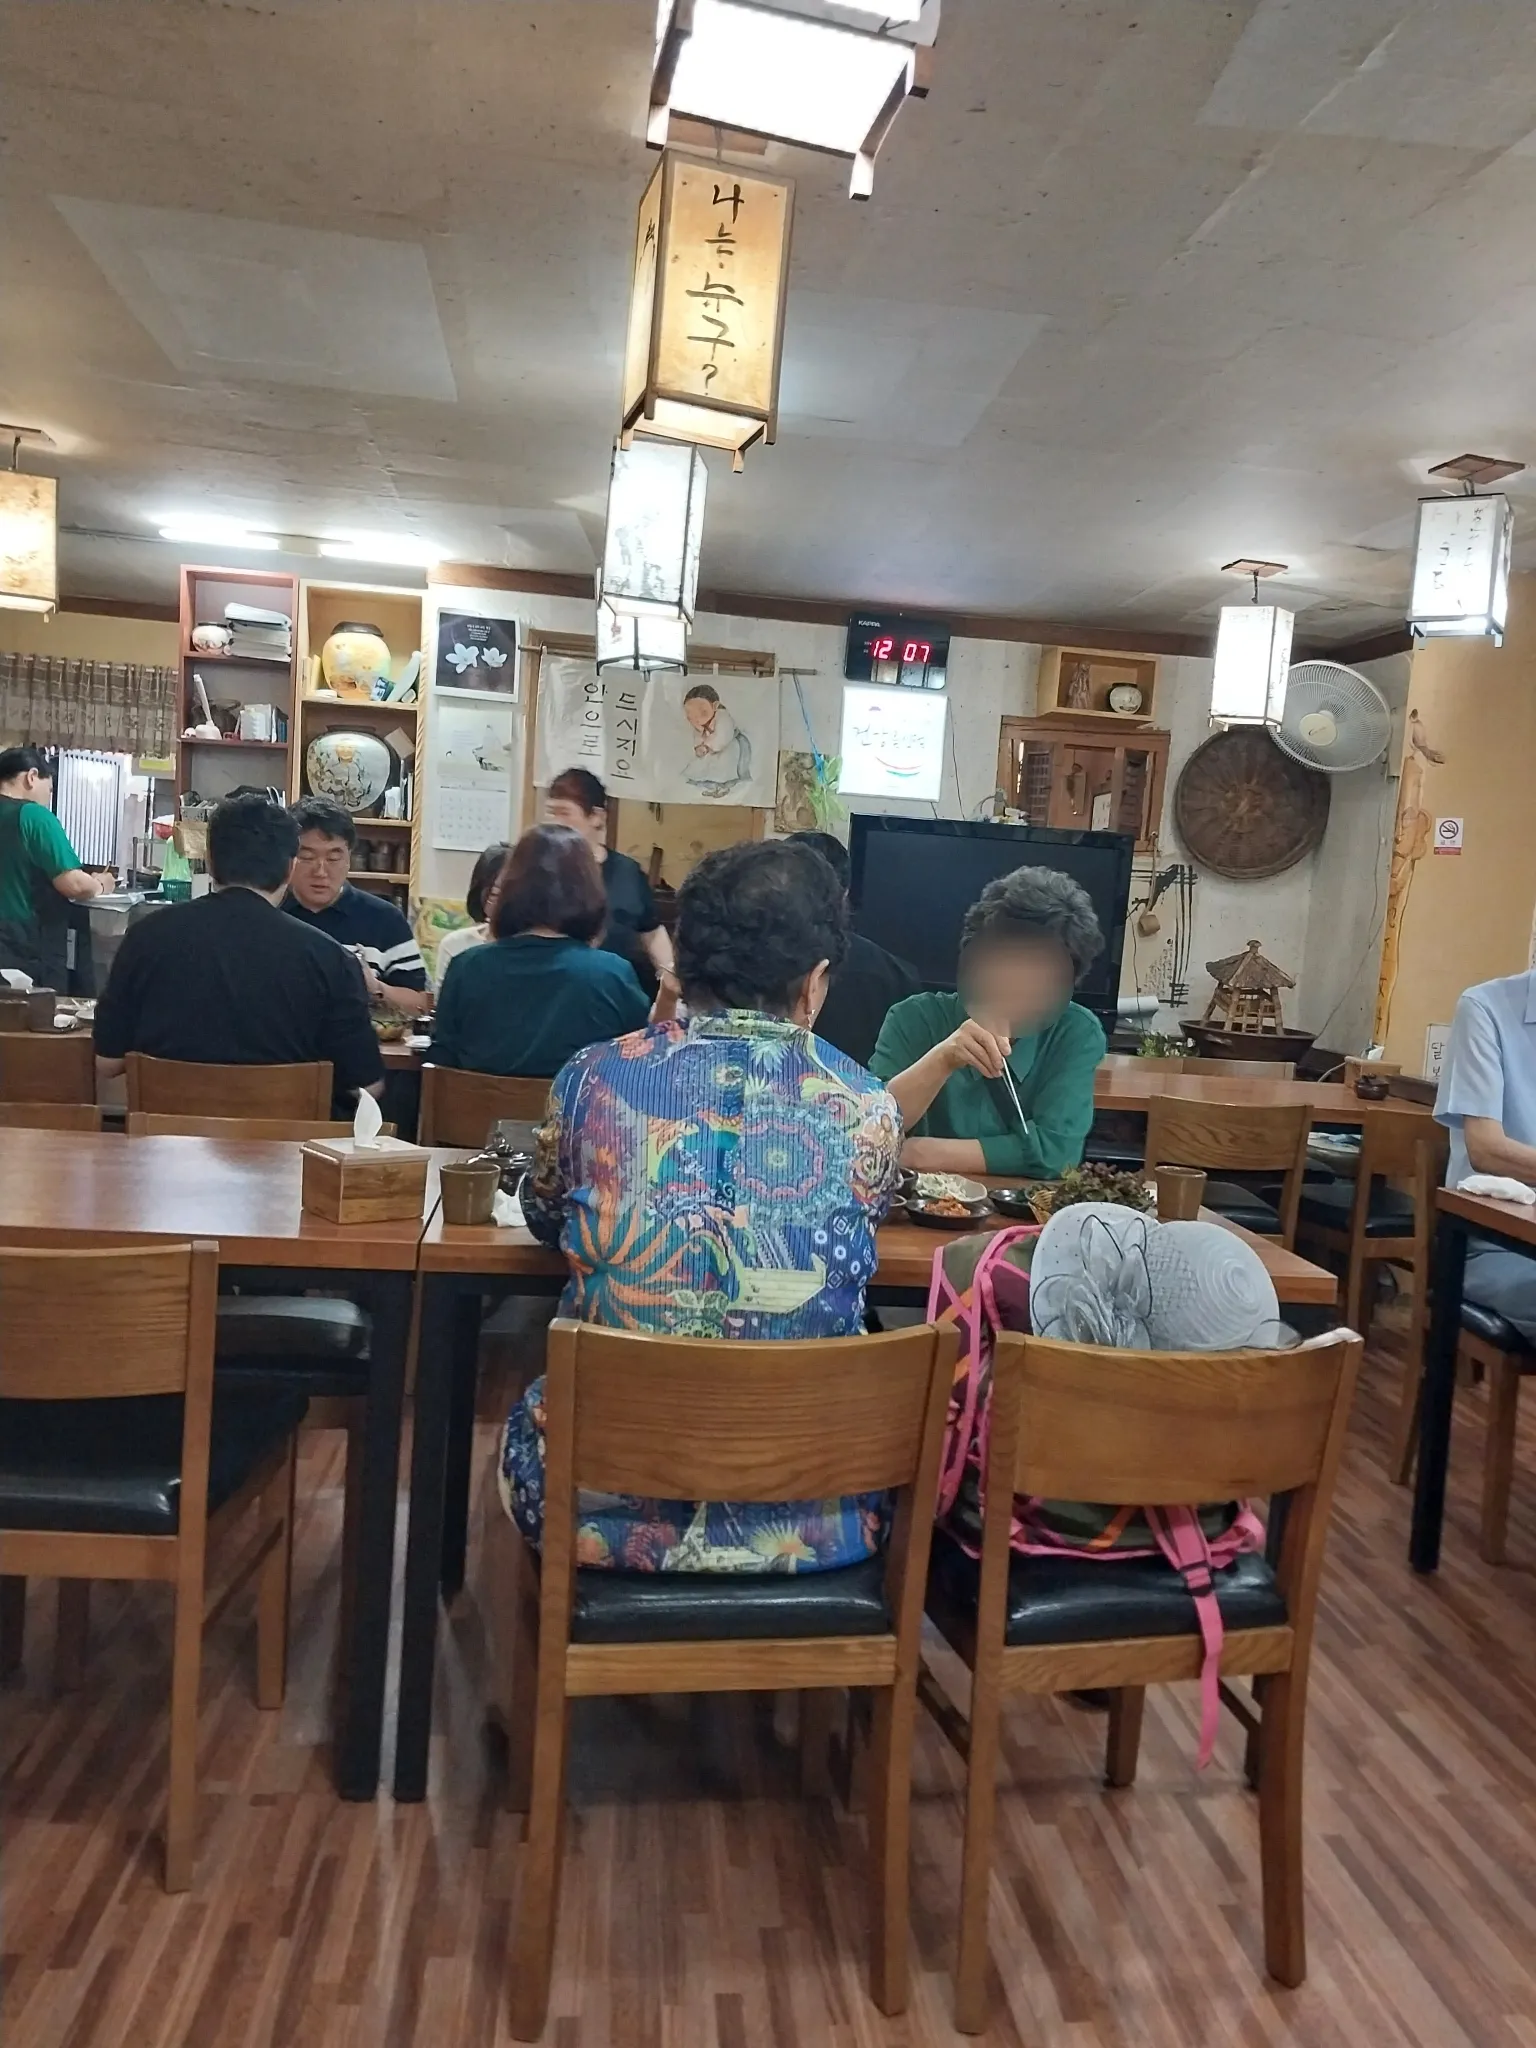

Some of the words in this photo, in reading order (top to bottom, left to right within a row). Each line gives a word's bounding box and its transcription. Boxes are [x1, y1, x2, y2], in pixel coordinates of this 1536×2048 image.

[704, 183, 745, 269] 나는
[685, 271, 745, 397] 누구?
[873, 640, 893, 660] 12
[903, 643, 930, 663] 07
[577, 682, 608, 757] 안으로
[610, 692, 638, 780] 드시지요
